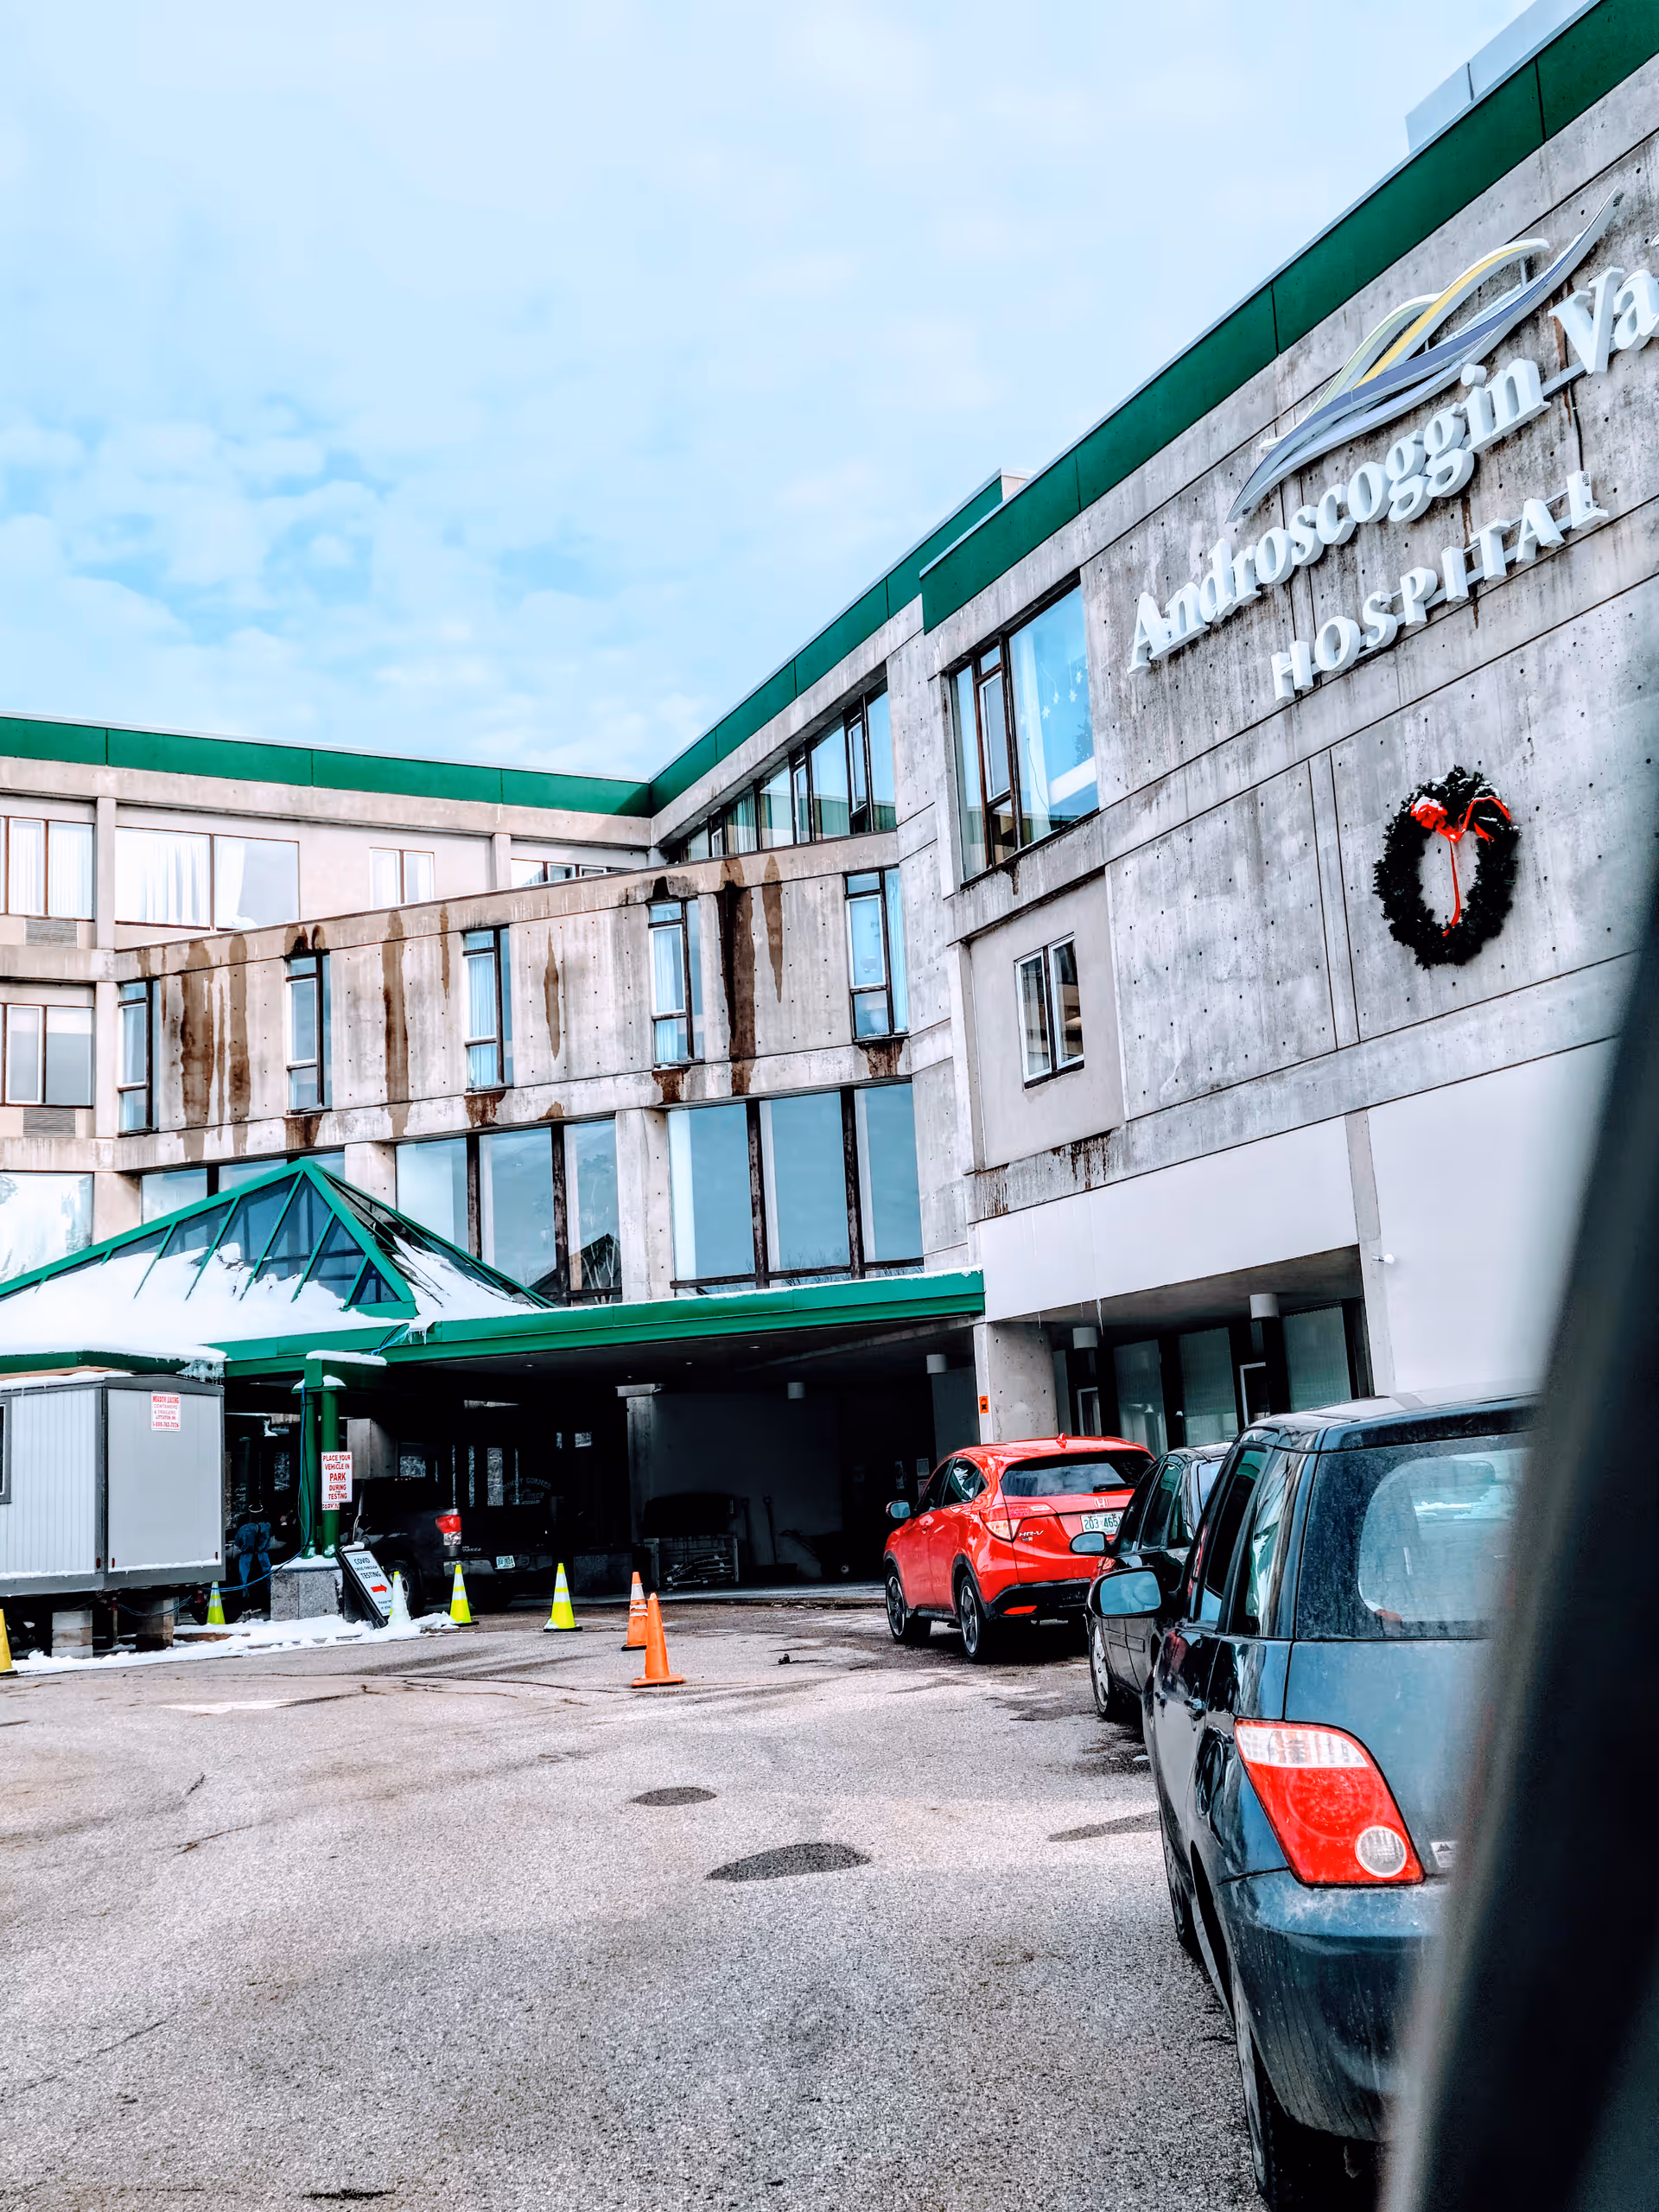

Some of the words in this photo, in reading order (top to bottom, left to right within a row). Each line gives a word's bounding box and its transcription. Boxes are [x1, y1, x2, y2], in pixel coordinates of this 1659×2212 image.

[1127, 358, 1551, 675] Androscoggin
[1548, 234, 1659, 375] Va
[1271, 469, 1609, 702] HOSPITAL
[329, 1472, 346, 1481] PARK
[1084, 1518, 1100, 1529] 203
[359, 1571, 382, 1580] TESTING
